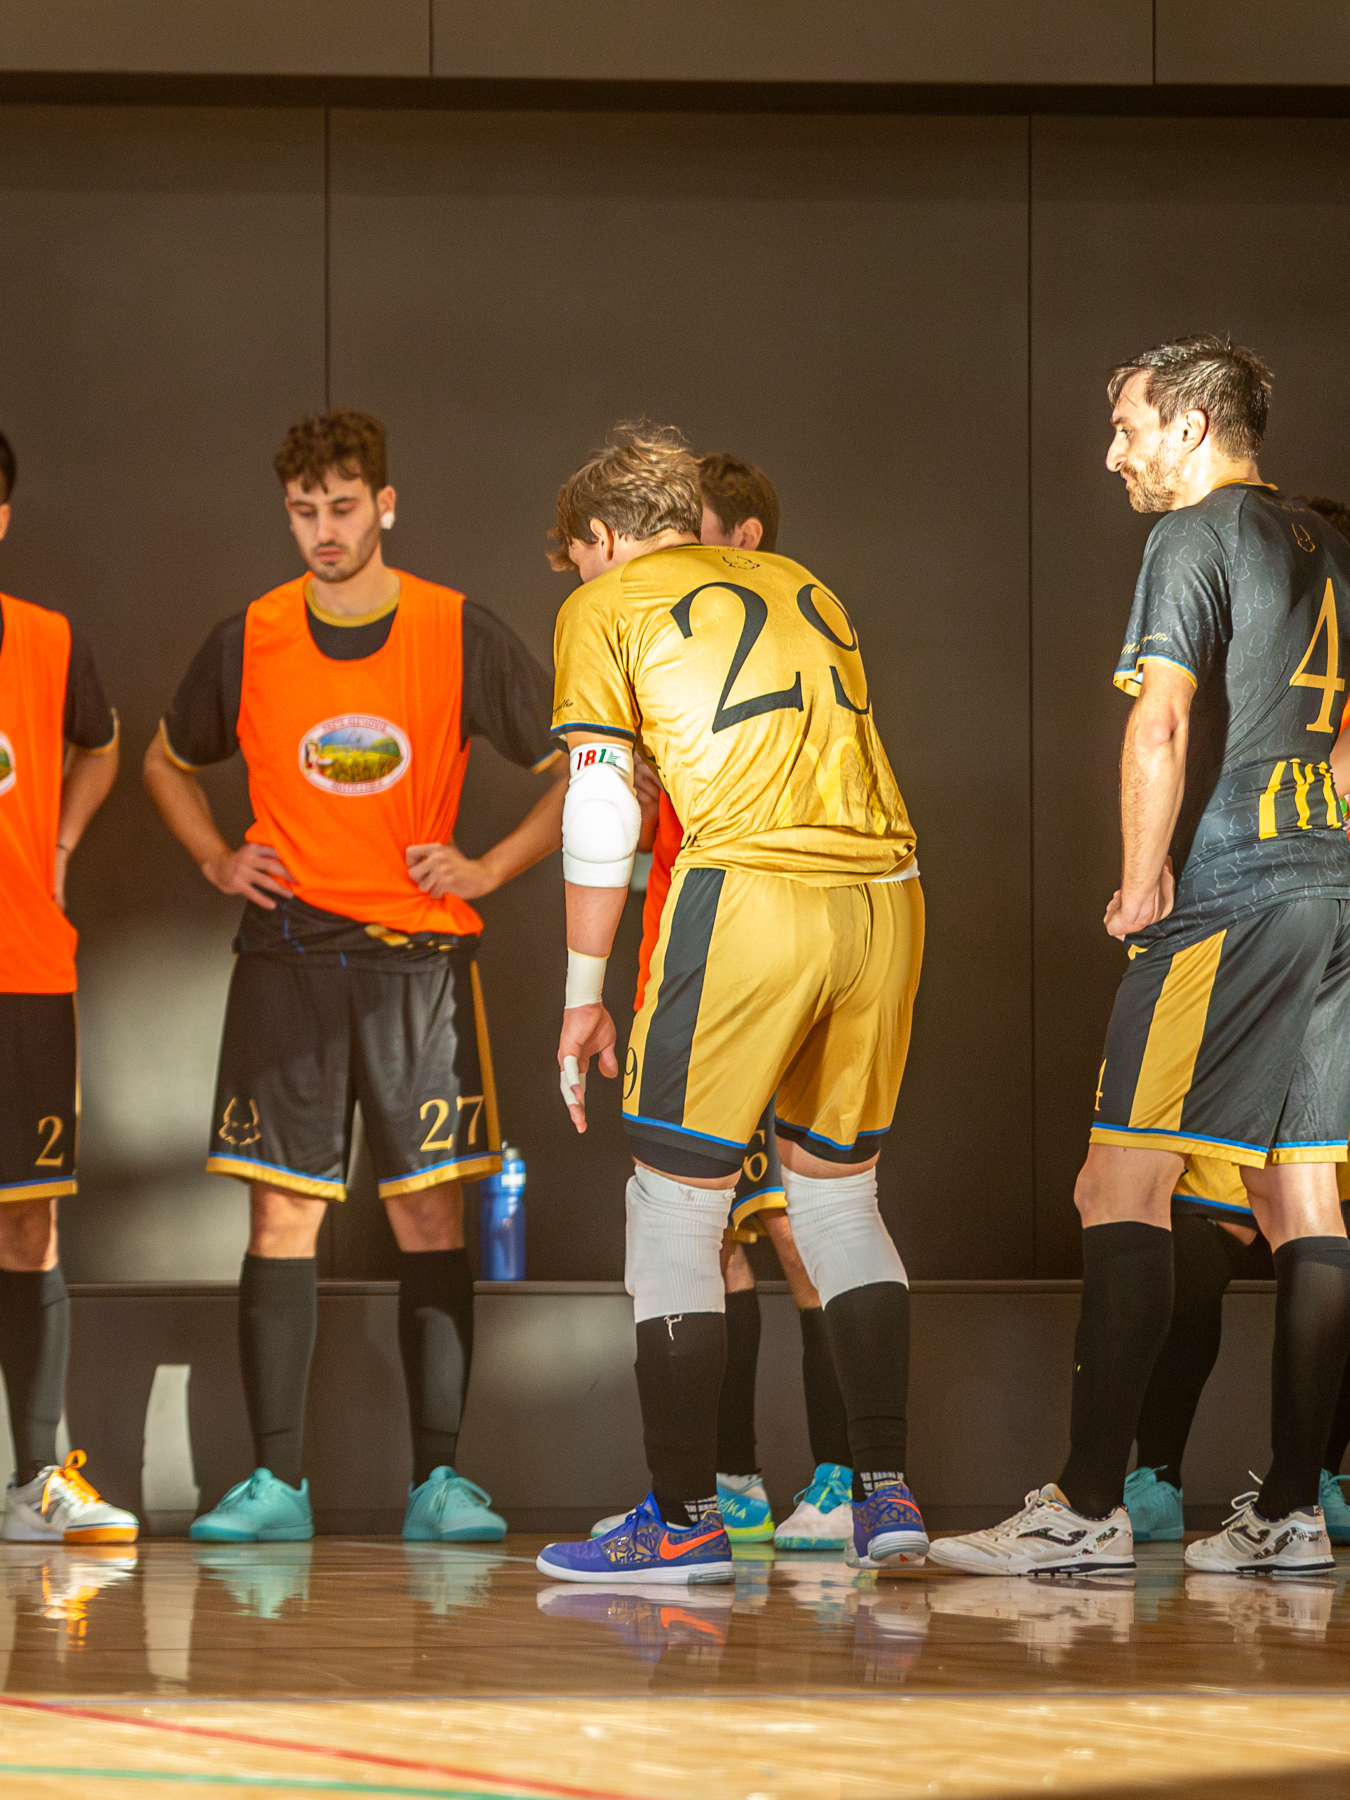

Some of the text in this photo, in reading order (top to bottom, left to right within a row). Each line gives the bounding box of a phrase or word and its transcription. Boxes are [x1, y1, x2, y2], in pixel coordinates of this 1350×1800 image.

[1288, 576, 1346, 734] 4
[35, 1115, 65, 1167] 2
[419, 1094, 485, 1153] 27
